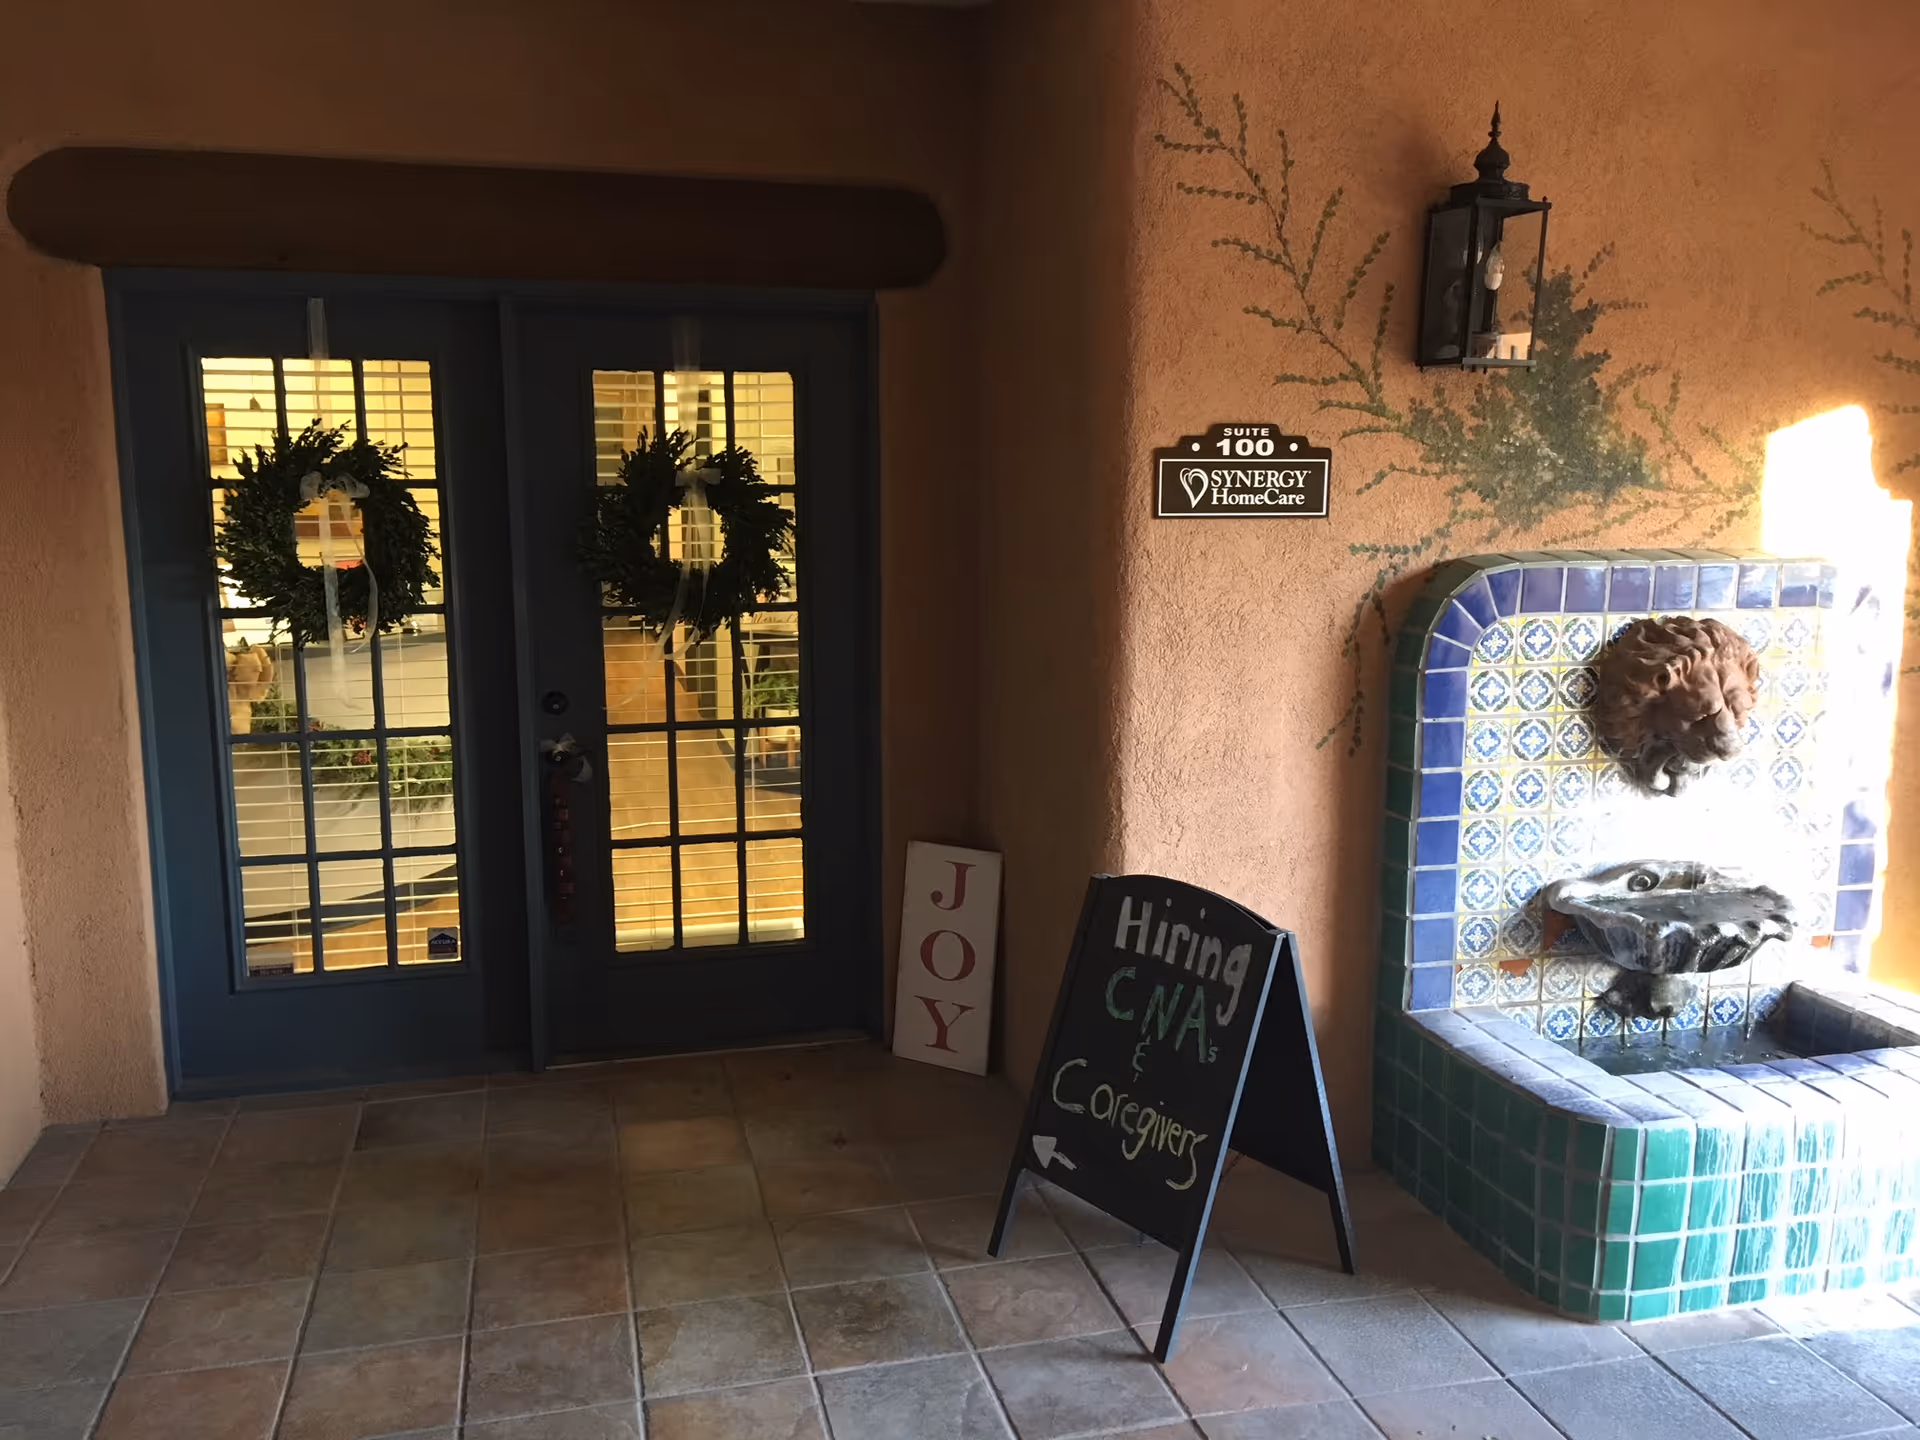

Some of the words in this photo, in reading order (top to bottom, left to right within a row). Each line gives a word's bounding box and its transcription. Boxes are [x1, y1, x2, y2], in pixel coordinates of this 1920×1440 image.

[1223, 427, 1270, 437] SUITE
[1216, 438, 1275, 456] 100
[1210, 470, 1307, 488] SYNERGY
[1210, 487, 1305, 506] HomeCare
[913, 860, 977, 1054] JOY
[1114, 895, 1252, 1027] Hiring
[1052, 1058, 1209, 1190] Caregivers
